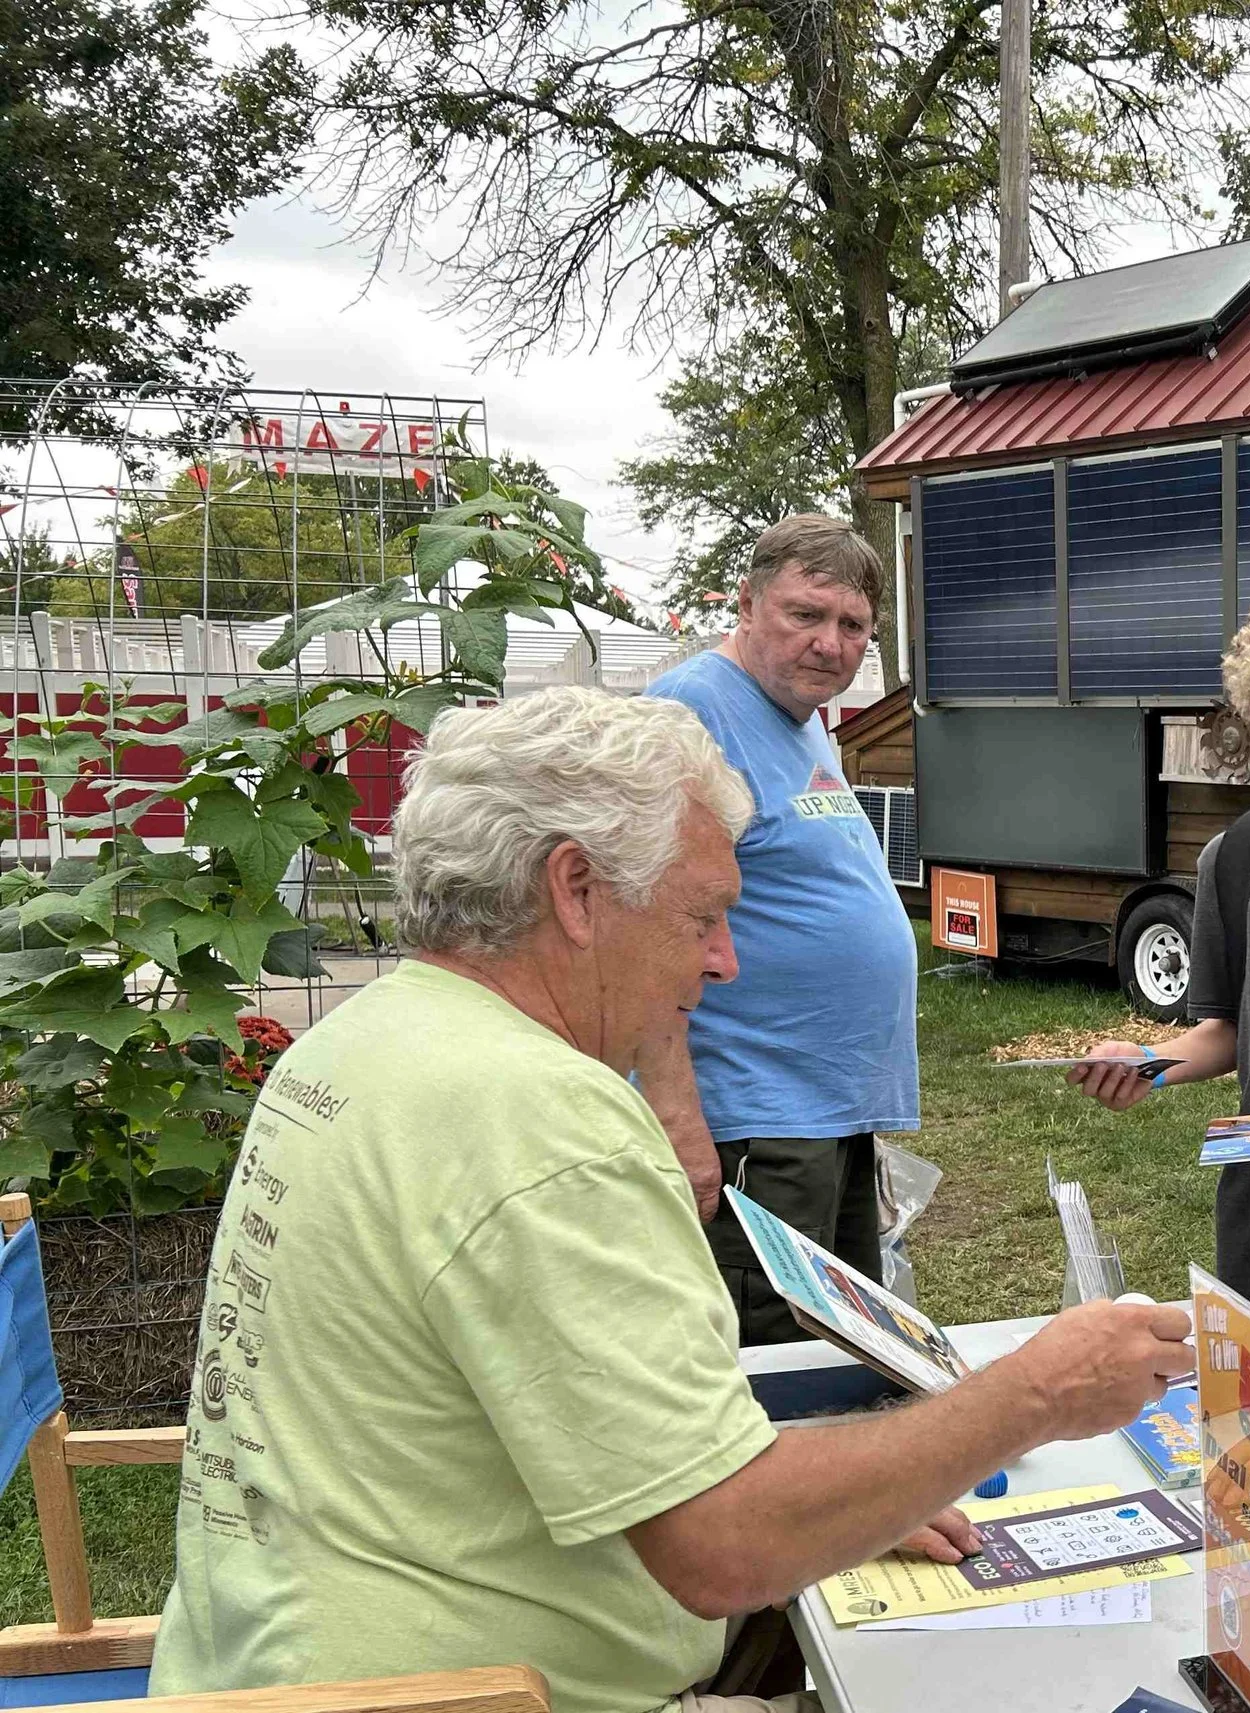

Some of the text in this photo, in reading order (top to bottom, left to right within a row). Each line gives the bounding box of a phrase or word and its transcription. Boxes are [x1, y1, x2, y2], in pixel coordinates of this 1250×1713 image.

[243, 419, 436, 458] MAZE
[794, 796, 823, 815] UP
[946, 896, 980, 911] THIS HOUSE
[950, 922, 975, 934] SALE
[953, 914, 971, 924] FOR
[274, 1068, 349, 1122] Renewables!
[254, 1161, 290, 1205] Energy
[1203, 1304, 1228, 1334] Enter
[1208, 1338, 1239, 1372] To Win
[236, 1432, 265, 1455] Horizon
[1204, 1432, 1246, 1490] Dual
[973, 1562, 1001, 1579] ECO
